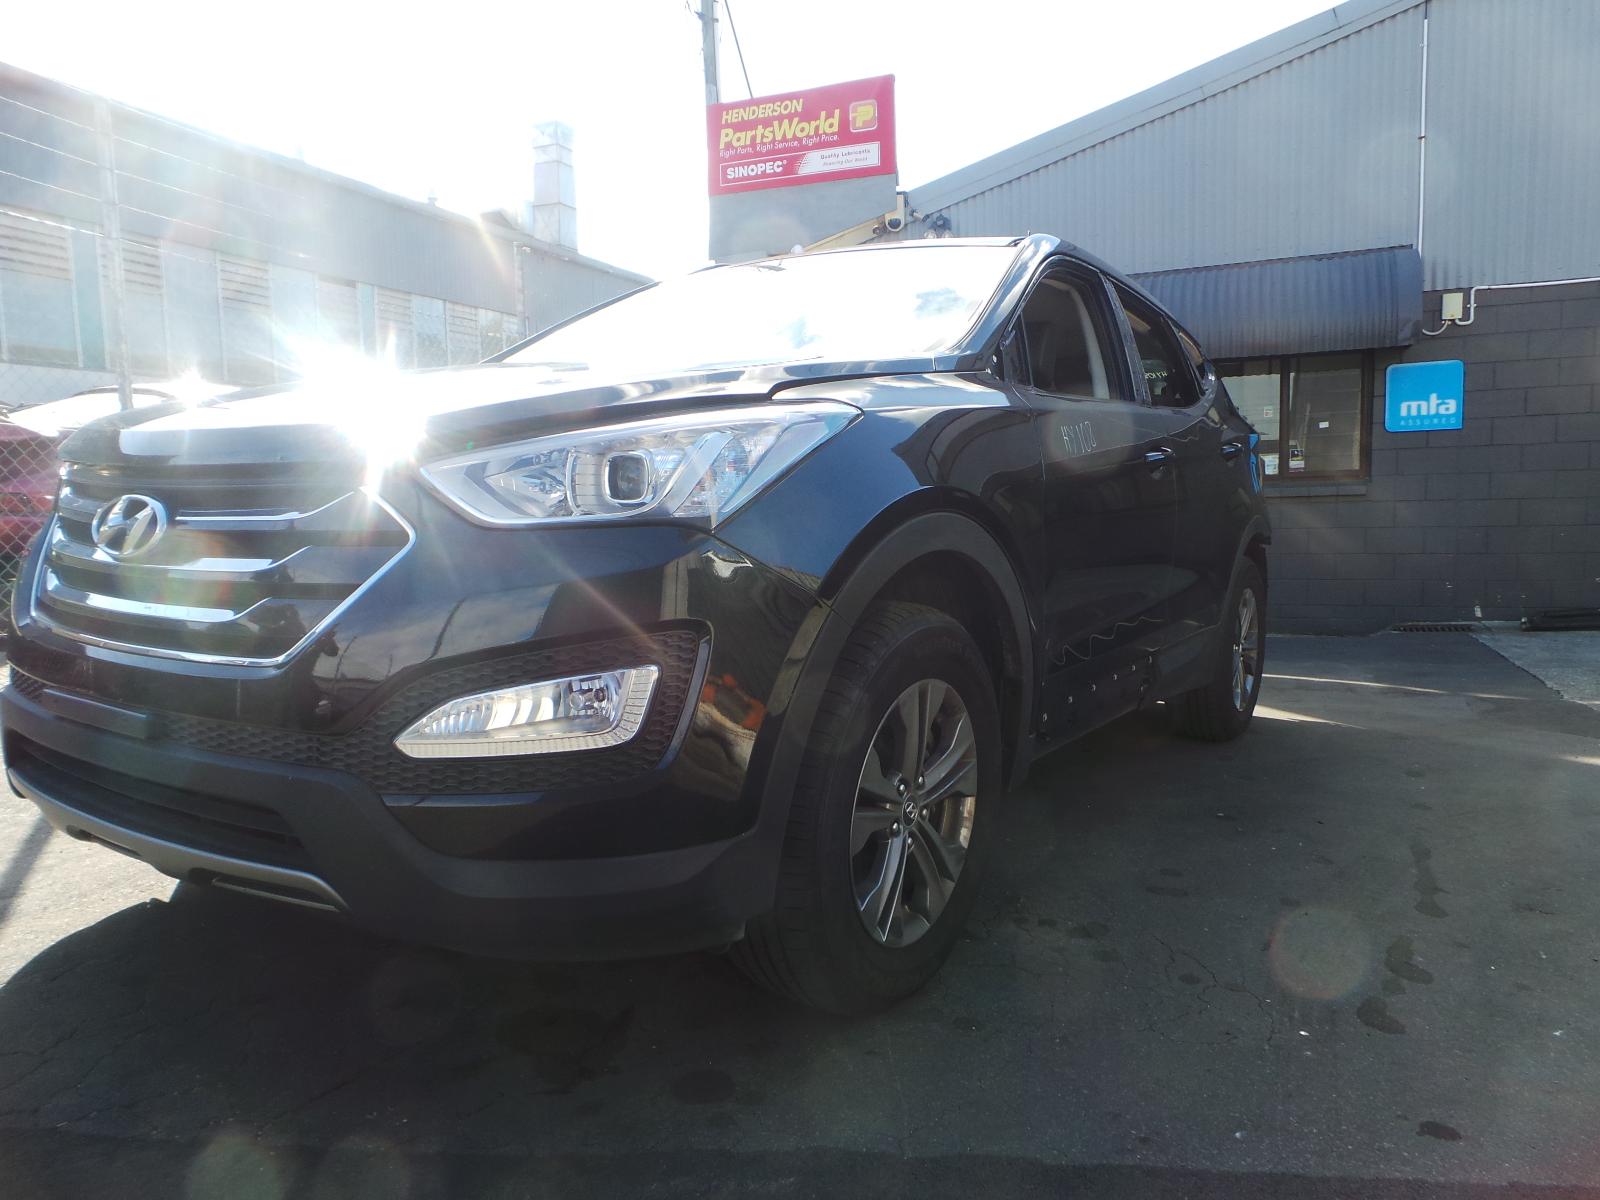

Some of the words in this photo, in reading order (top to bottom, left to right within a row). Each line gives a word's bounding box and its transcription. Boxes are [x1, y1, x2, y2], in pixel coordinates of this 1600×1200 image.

[721, 98, 803, 125] HENDERSON
[719, 109, 840, 149] PartsWorld
[719, 148, 736, 158] Right
[756, 143, 773, 153] Right
[774, 140, 800, 150] Service,
[802, 136, 820, 146] Right
[1400, 393, 1457, 417] mta
